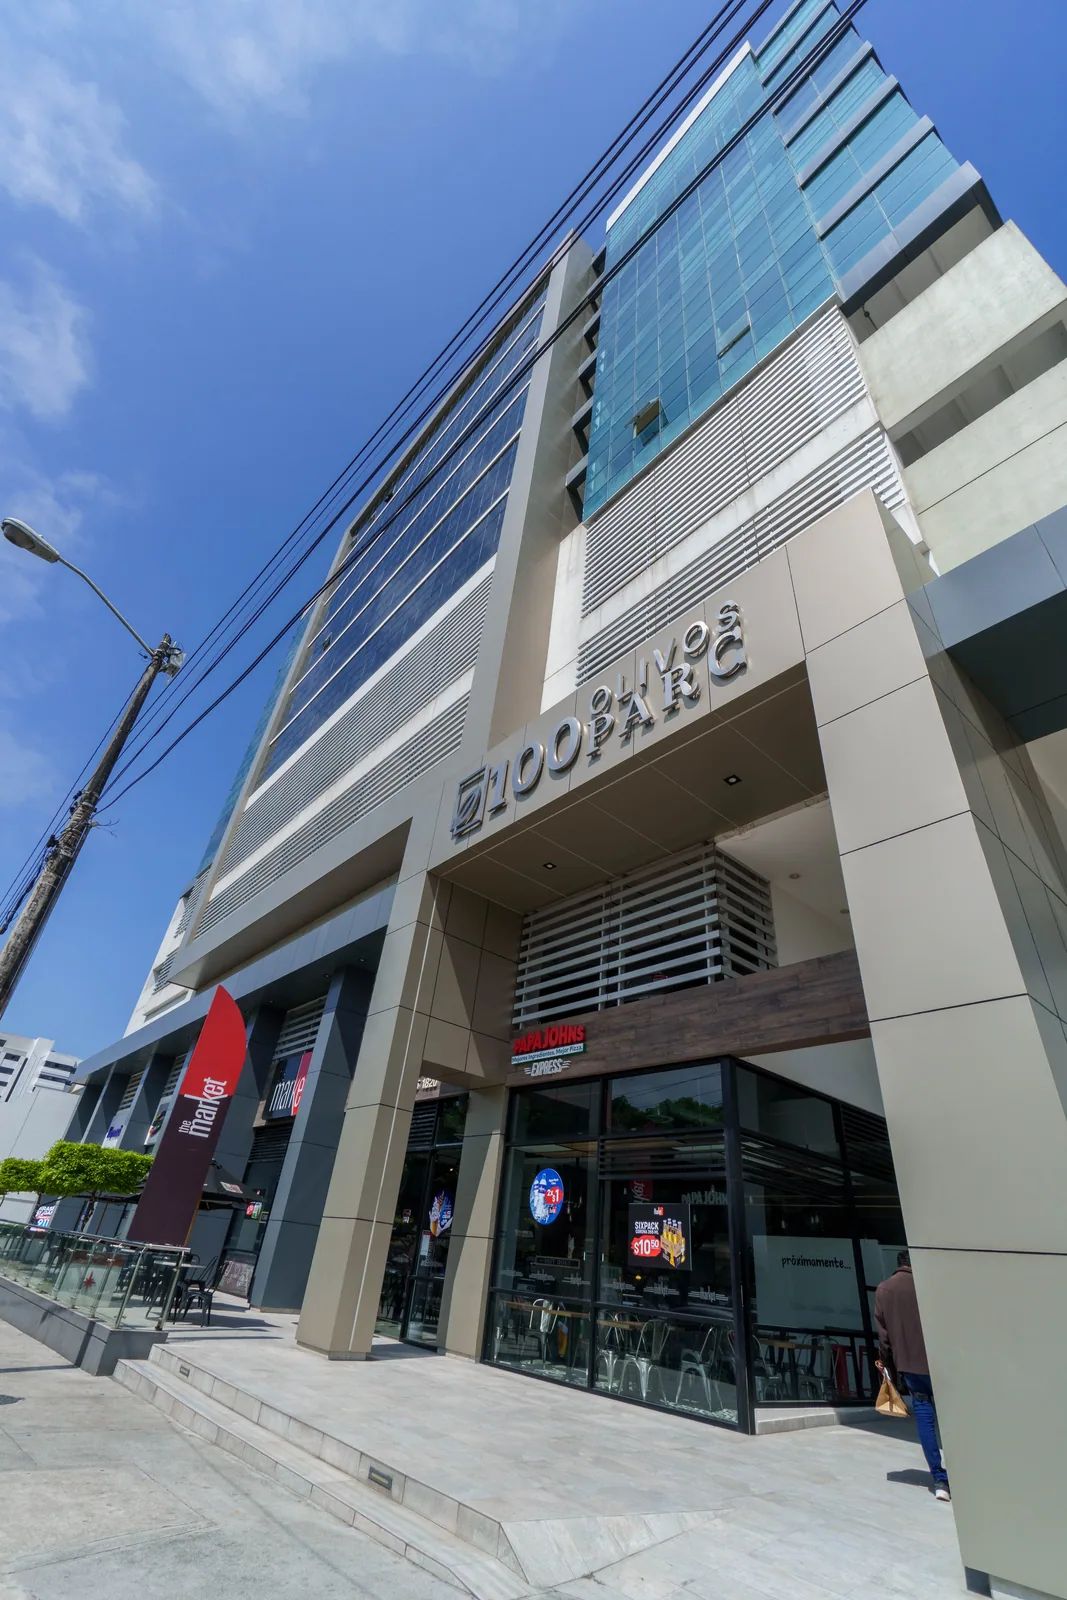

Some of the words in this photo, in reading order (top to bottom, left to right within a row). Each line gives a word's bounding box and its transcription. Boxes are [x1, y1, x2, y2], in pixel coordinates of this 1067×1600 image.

[589, 600, 742, 717] OLIVOS
[487, 716, 582, 815] 100
[587, 625, 747, 759] PARC
[514, 1031, 541, 1054] PAPA
[540, 1025, 586, 1048] JOHNS
[531, 1059, 564, 1077] EXPRESS
[184, 1077, 228, 1138] market
[269, 1076, 306, 1116] marke
[178, 1120, 191, 1134] the
[634, 1221, 660, 1231] SIXPACK
